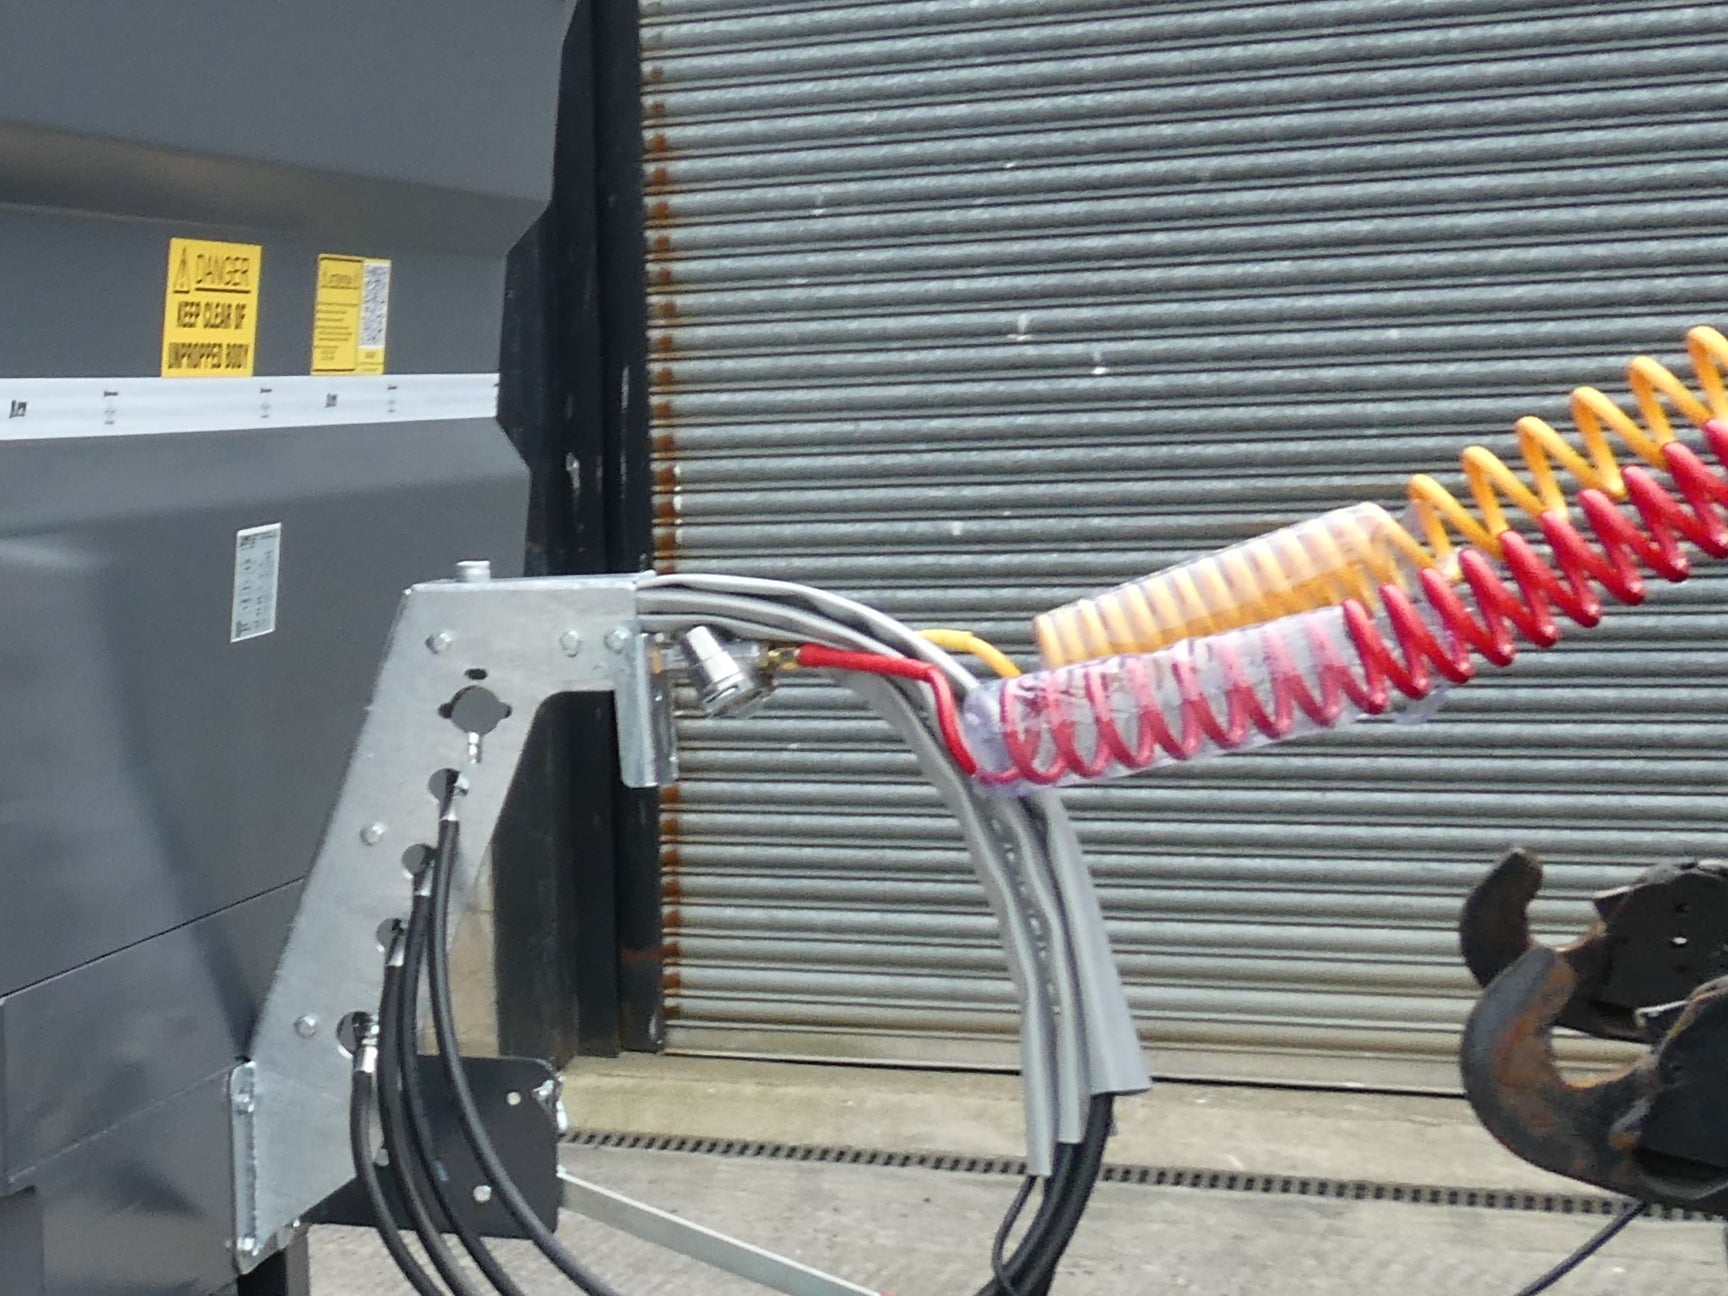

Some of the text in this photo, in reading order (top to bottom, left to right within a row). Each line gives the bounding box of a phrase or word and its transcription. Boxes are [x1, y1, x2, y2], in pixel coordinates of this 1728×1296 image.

[195, 253, 250, 287] DANGER
[176, 301, 247, 331] KEEP CLEAR OF
[168, 341, 249, 369] UNPROPPED BODY
